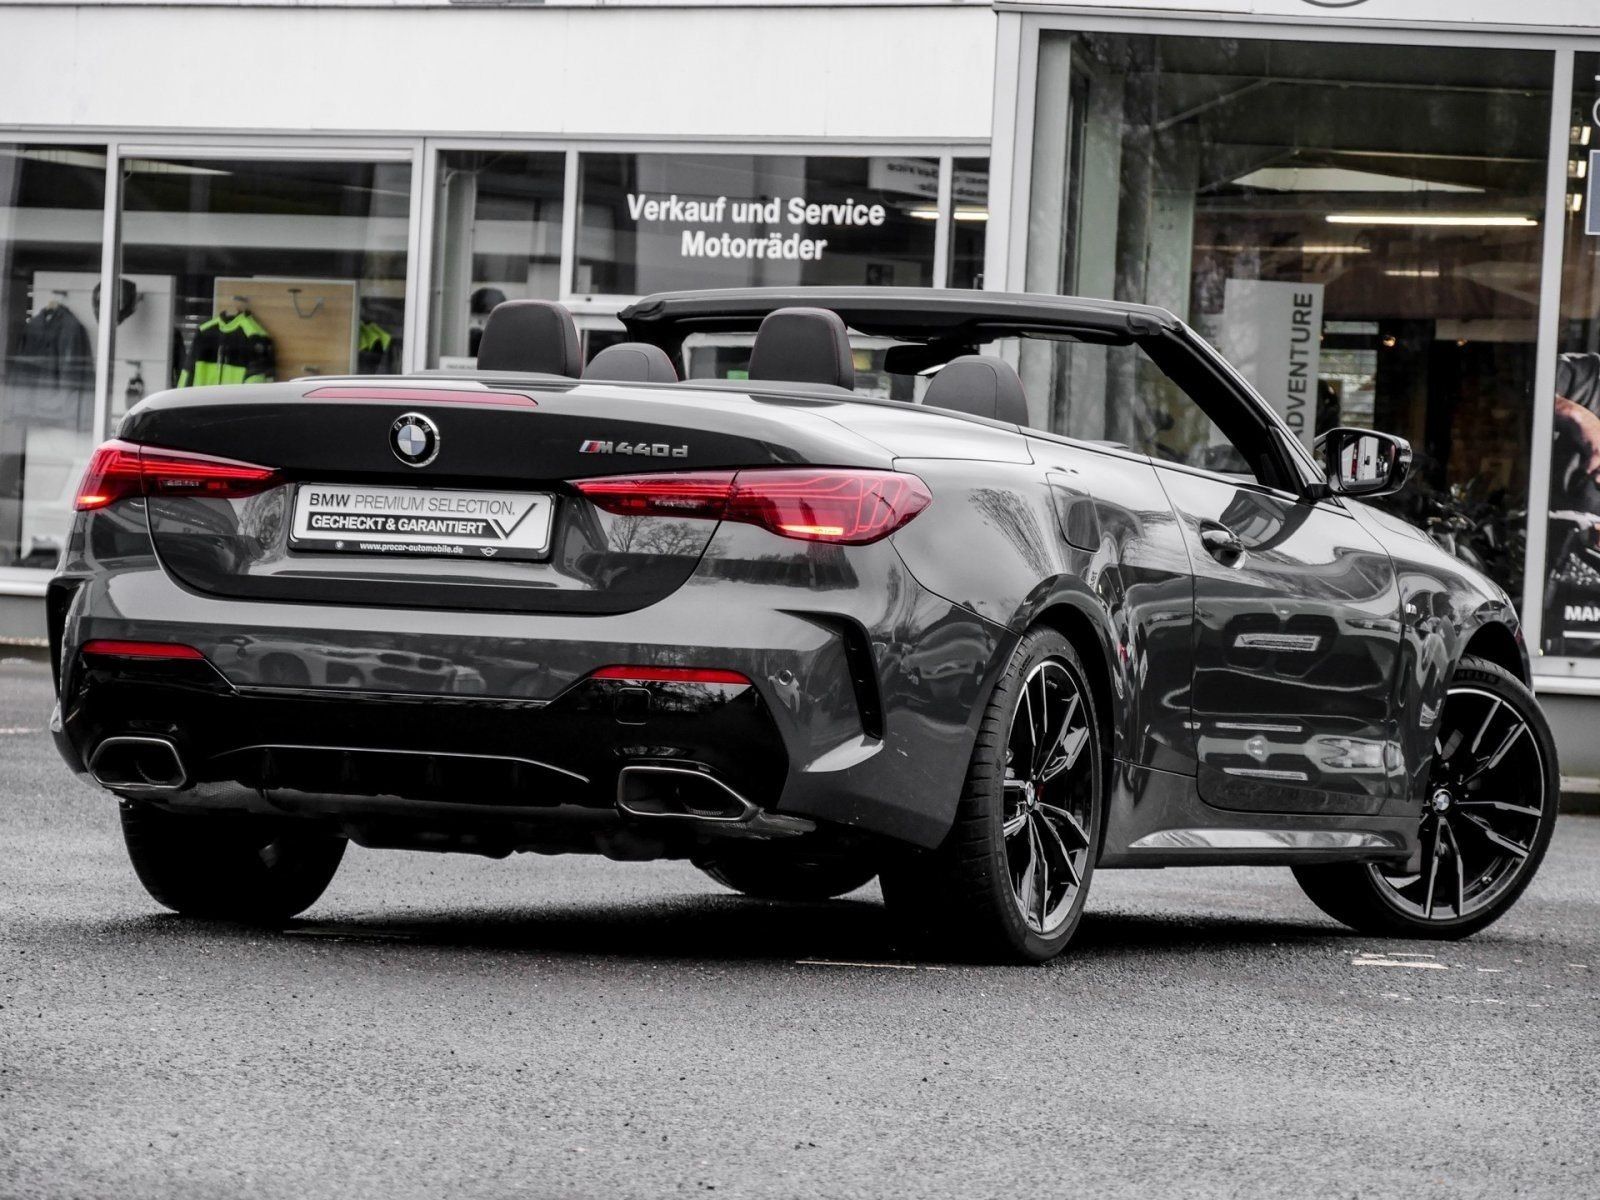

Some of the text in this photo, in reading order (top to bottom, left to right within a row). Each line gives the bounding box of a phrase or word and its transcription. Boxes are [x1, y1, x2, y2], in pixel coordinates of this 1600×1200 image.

[627, 193, 886, 226] Verkauf und Service
[681, 230, 828, 260] Motorräder
[309, 493, 515, 515] BMW PREMIUM SELECTION.
[312, 516, 486, 535] GECHECKT & GARANTIERT
[360, 542, 463, 554] www.procar-automobile.de
